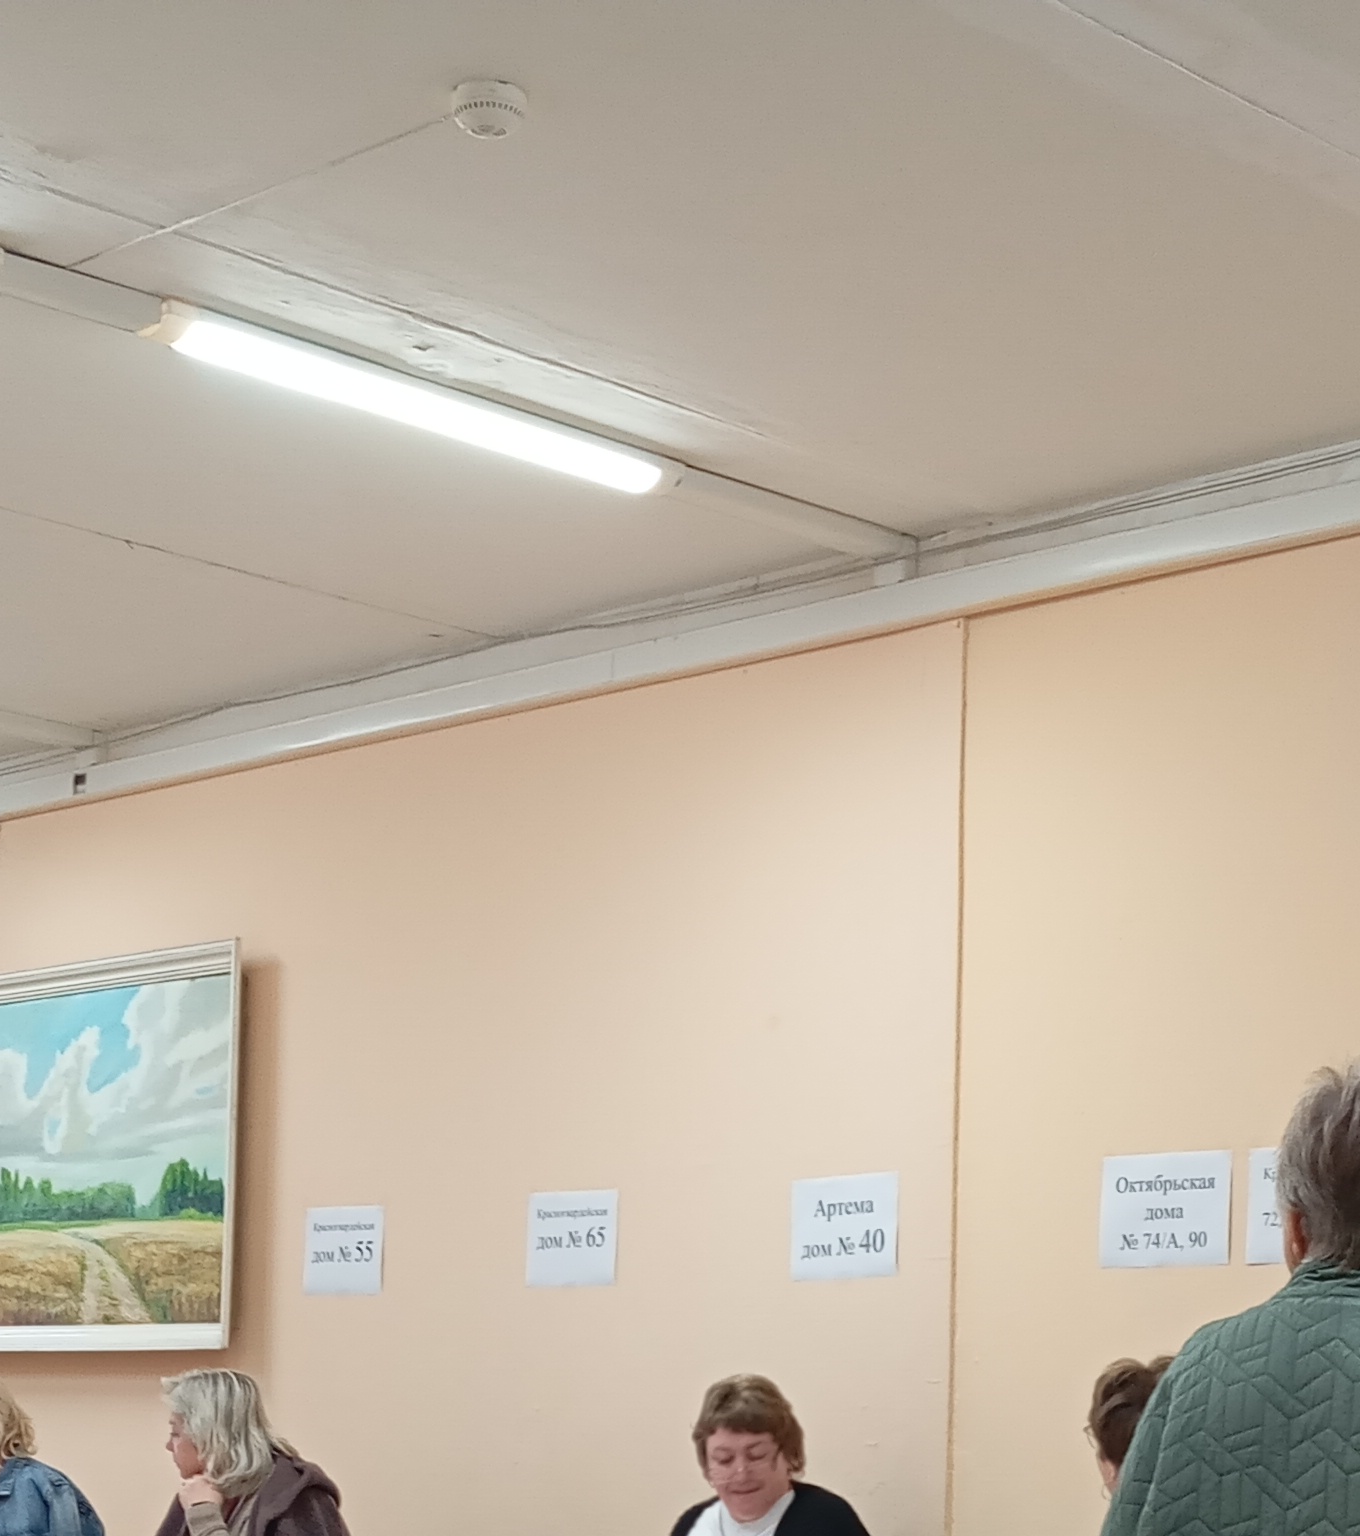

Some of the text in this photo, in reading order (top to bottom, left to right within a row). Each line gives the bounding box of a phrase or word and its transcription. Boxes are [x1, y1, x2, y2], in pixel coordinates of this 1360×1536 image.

[1115, 1174, 1216, 1196] Октябрьская
[813, 1199, 875, 1222] Артема
[1143, 1206, 1184, 1221] дома
[536, 1235, 563, 1251] дом
[585, 1226, 606, 1248] 65
[800, 1243, 832, 1260] дом
[858, 1228, 886, 1254] 40
[1188, 1231, 1208, 1248] 90
[311, 1251, 335, 1264] дом
[354, 1240, 374, 1263] 55
